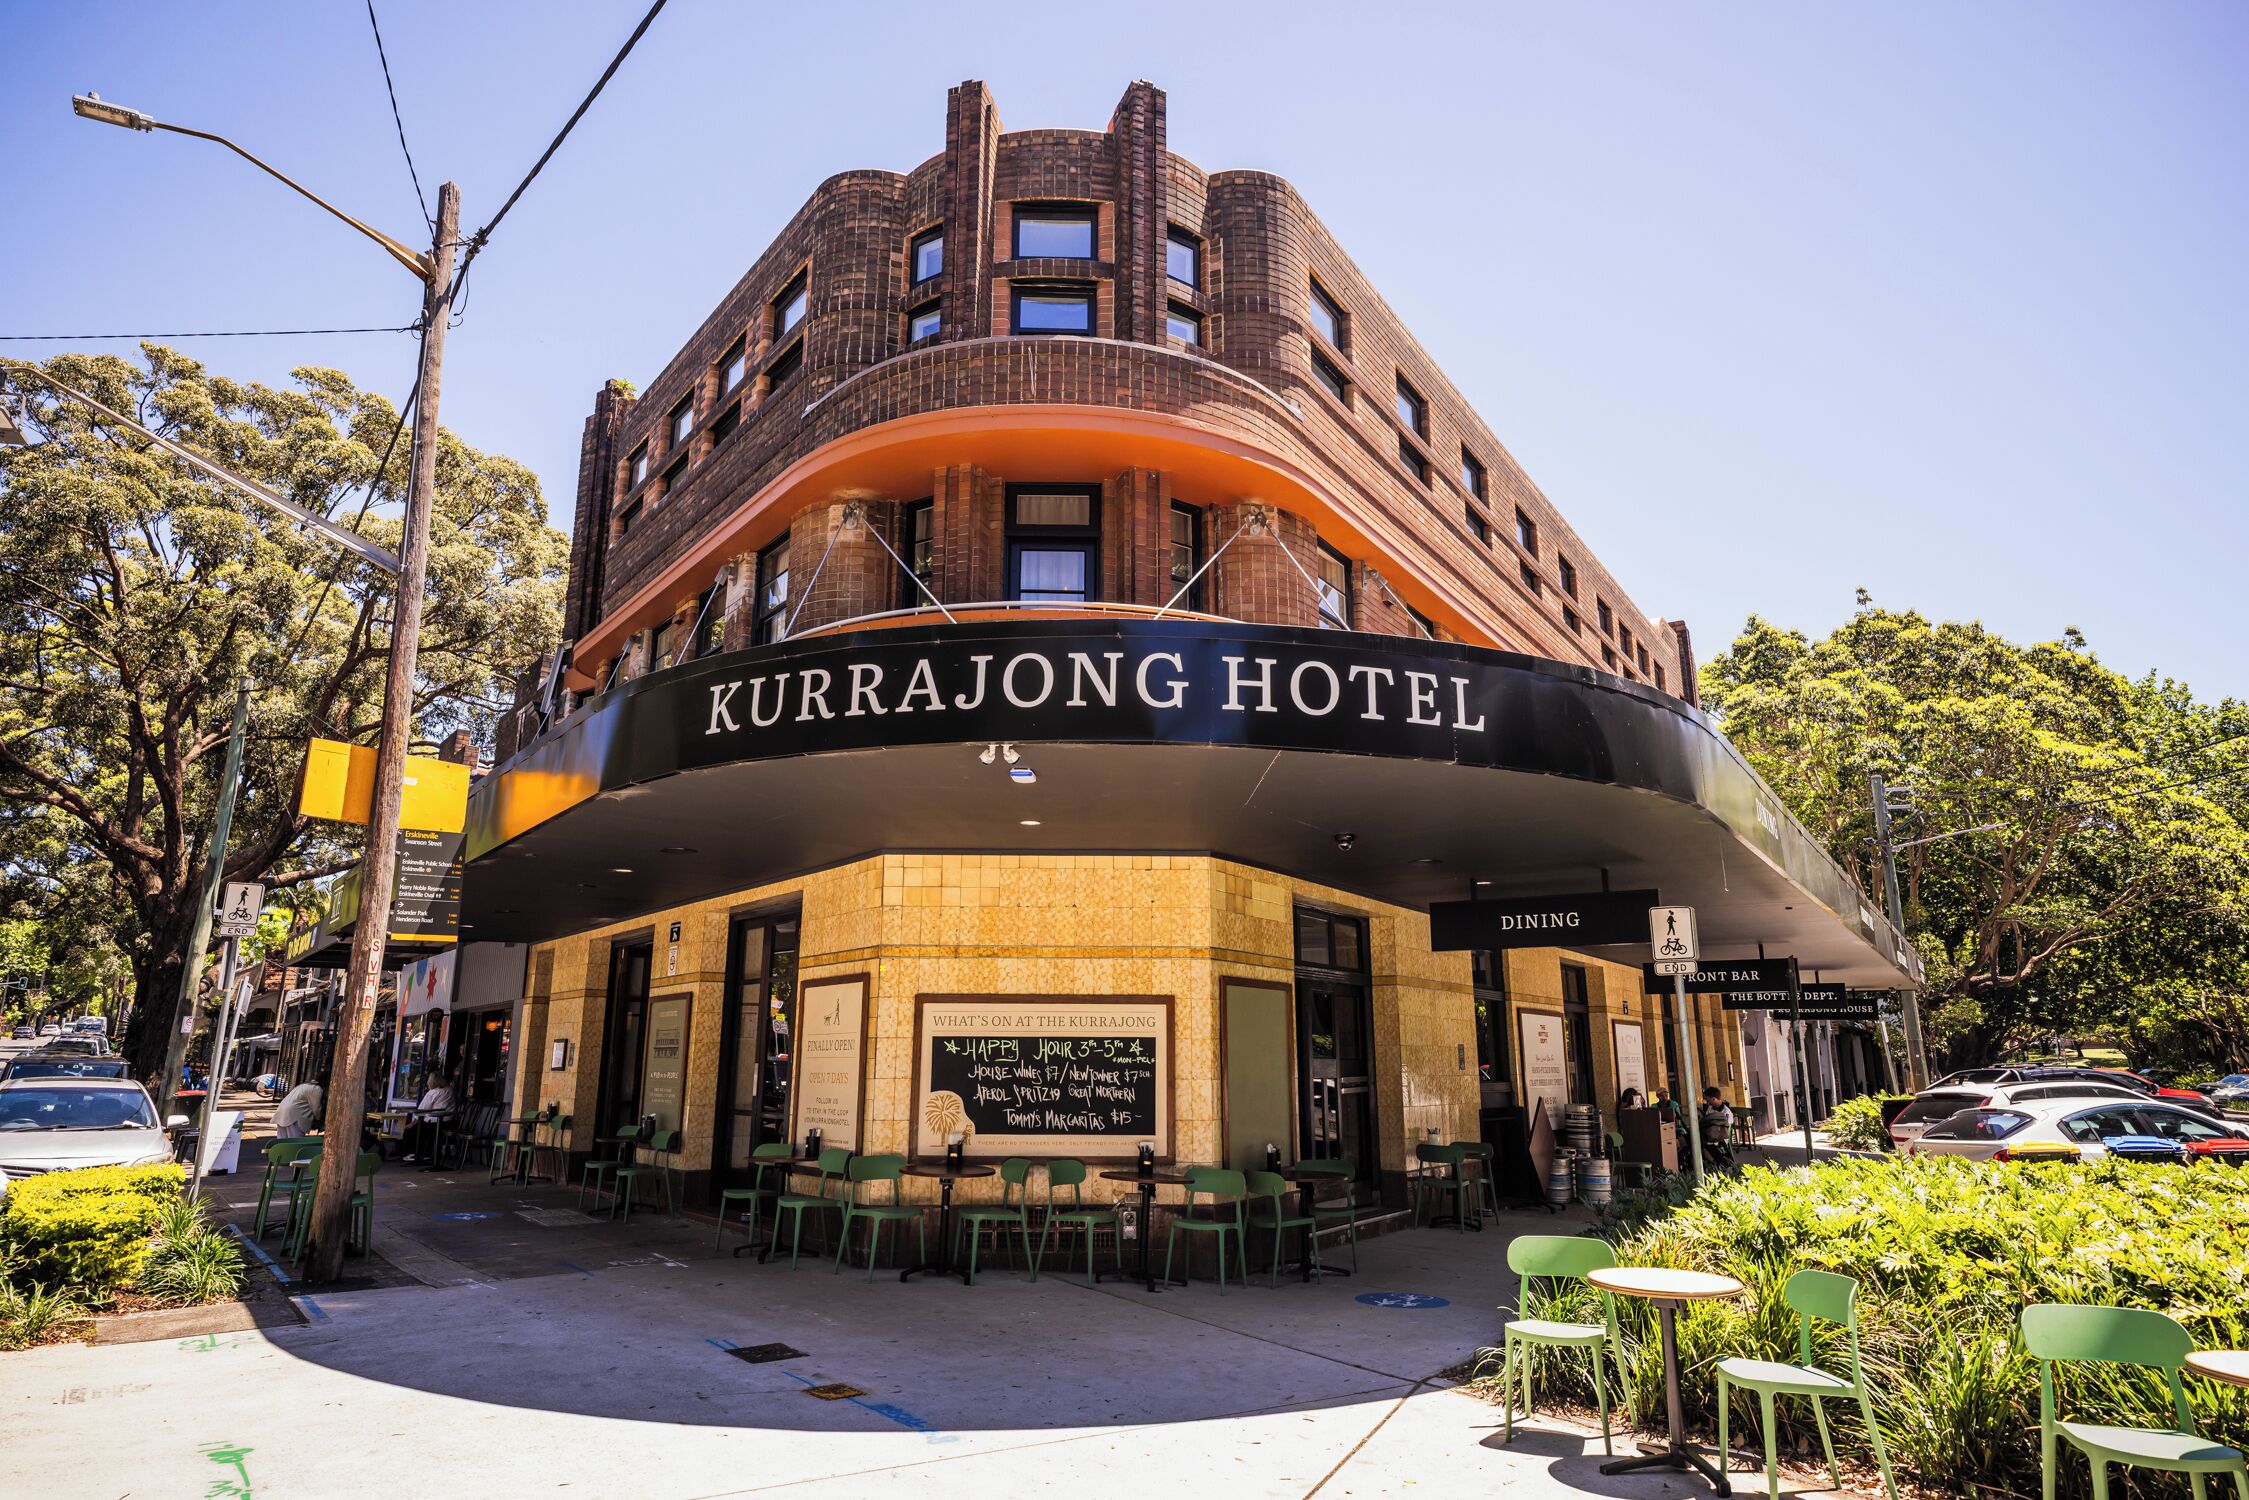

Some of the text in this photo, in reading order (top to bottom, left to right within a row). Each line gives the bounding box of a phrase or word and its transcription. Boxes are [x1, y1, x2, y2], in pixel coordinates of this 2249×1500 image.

[705, 652, 1485, 736] KURRAJONG HOTEL
[404, 830, 439, 840] Erskineville
[1502, 912, 1580, 930] DINING
[1664, 963, 1687, 972] END
[1732, 970, 1760, 981] BAR
[1730, 993, 1753, 1001] THE
[1804, 992, 1838, 1000] DEPT.
[933, 1015, 1156, 1027] WHAT'S ON AT THE KURRAJONG
[808, 1039, 856, 1052] FINALLY OPEN!
[962, 1038, 1019, 1061] HAPPY
[1033, 1038, 1077, 1064] HOUR
[809, 1072, 848, 1084] OPEN 7 DAYS
[968, 1064, 1012, 1081] HOUSE
[1014, 1060, 1042, 1084] WINES
[1045, 1066, 1060, 1082] $7
[973, 1084, 1012, 1107] APEROL
[1068, 1083, 1092, 1108] GREAT
[1095, 1085, 1136, 1104] NORTHERN
[1002, 1108, 1042, 1128] TOMMY'S
[1045, 1109, 1105, 1131] MARGARITAS
